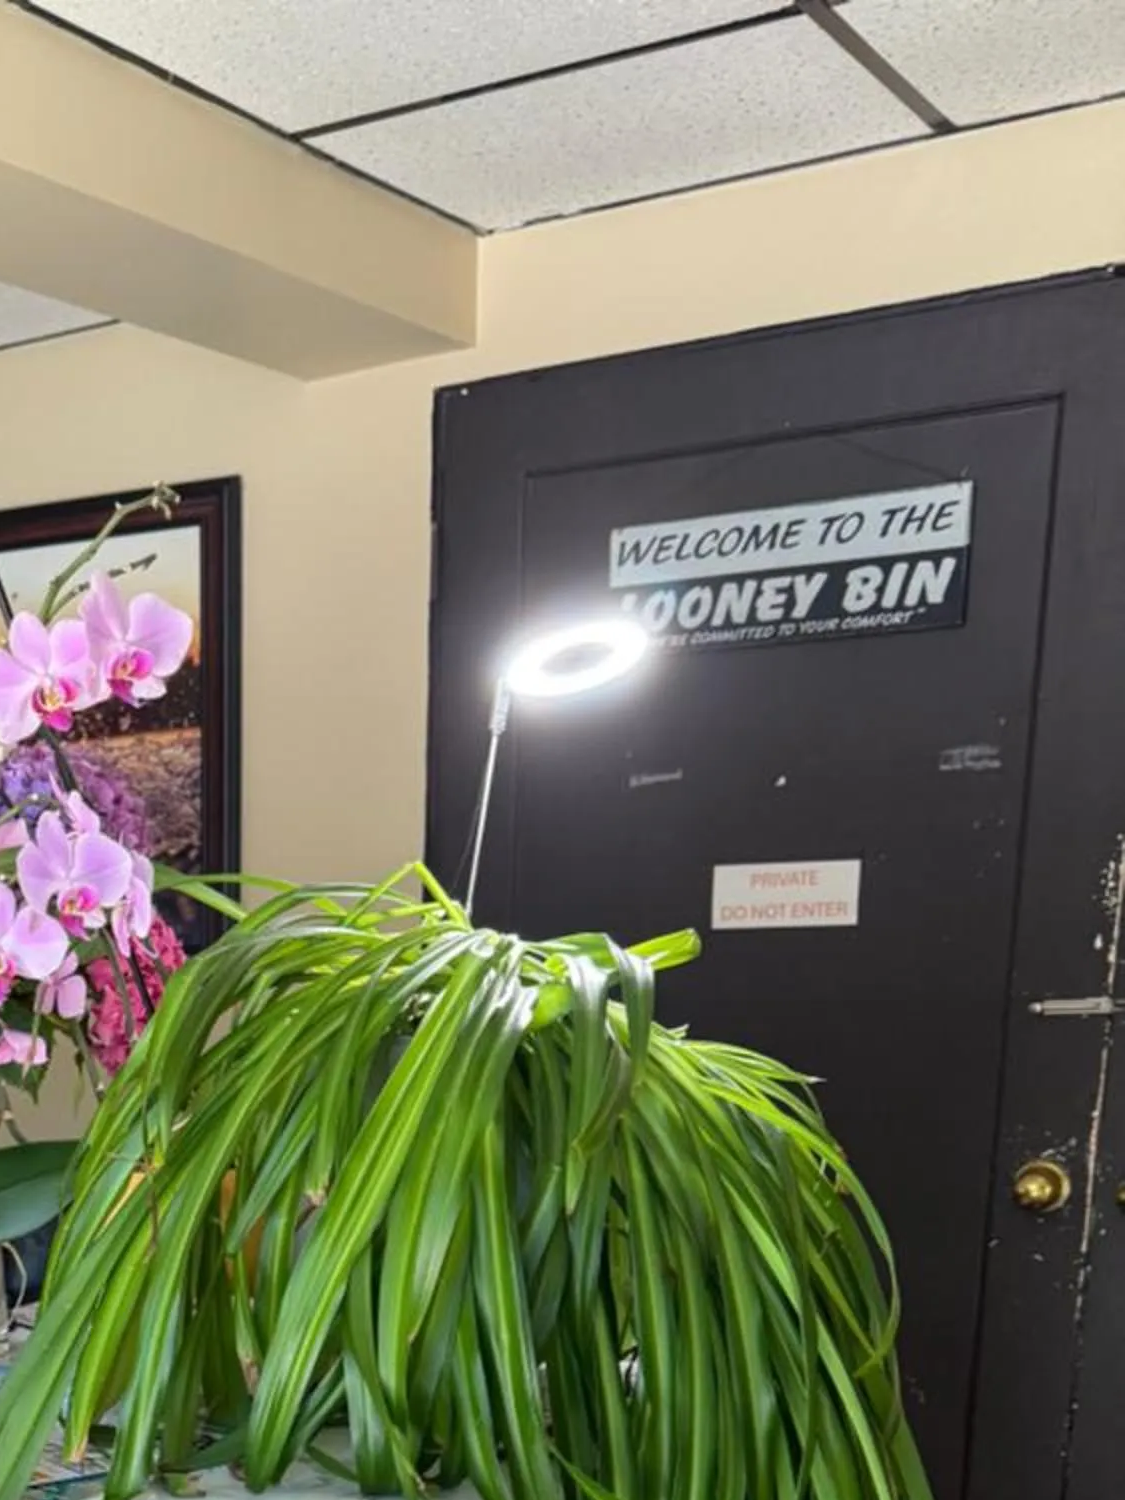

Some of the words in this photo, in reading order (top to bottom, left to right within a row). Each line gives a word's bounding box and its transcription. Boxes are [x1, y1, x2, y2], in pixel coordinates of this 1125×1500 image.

[617, 518, 806, 568] WELCOME
[818, 511, 865, 547] TO
[879, 500, 960, 538] THE
[842, 556, 958, 614] BIN
[777, 621, 797, 637] TO
[749, 869, 819, 889] PRIVATE
[720, 905, 748, 921] DO
[750, 903, 786, 920] NOT
[790, 901, 848, 919] ENTER
